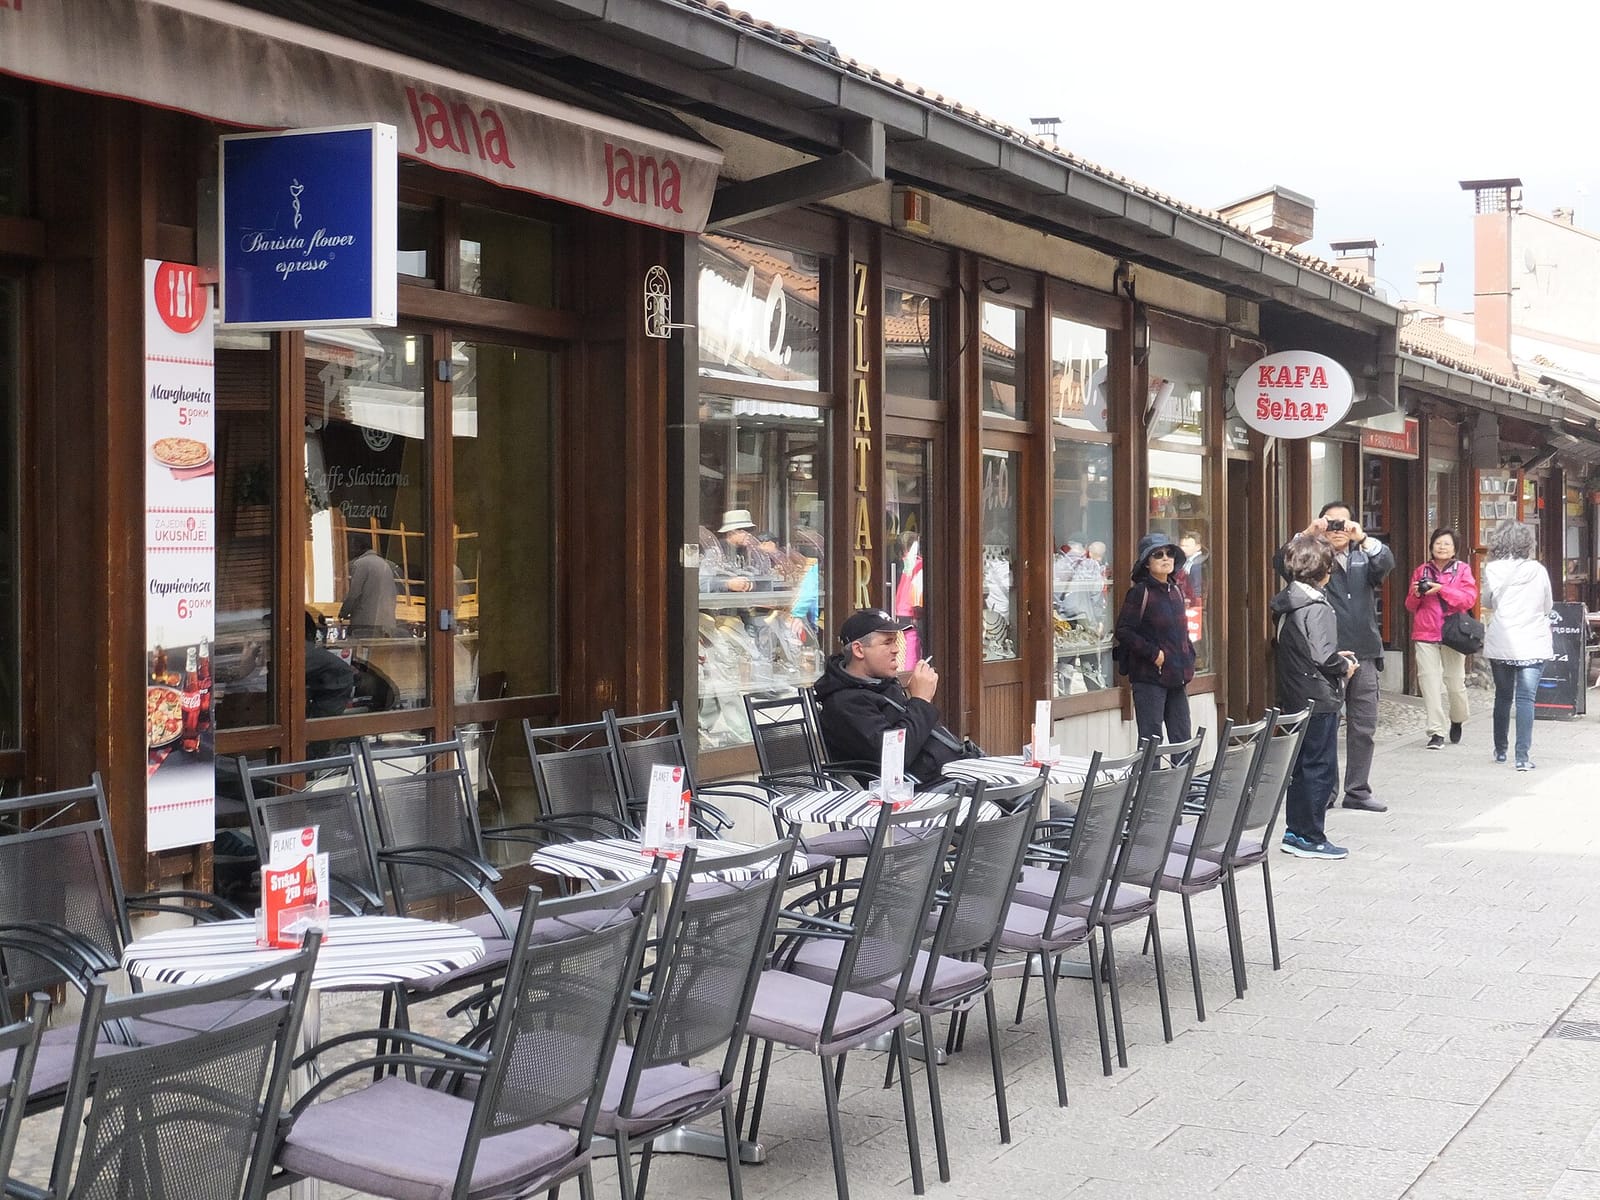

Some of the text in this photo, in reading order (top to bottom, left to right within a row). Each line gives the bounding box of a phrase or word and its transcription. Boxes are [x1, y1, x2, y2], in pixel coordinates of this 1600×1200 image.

[303, 227, 356, 256] flower
[275, 259, 329, 281] espresso
[1257, 365, 1329, 389] KAFA
[150, 383, 212, 405] Margherita
[1256, 392, 1329, 421] Šehar
[854, 262, 873, 609] ZLATAR
[310, 464, 410, 494] Caffe Slastičarna
[340, 499, 388, 519] Pizzeria
